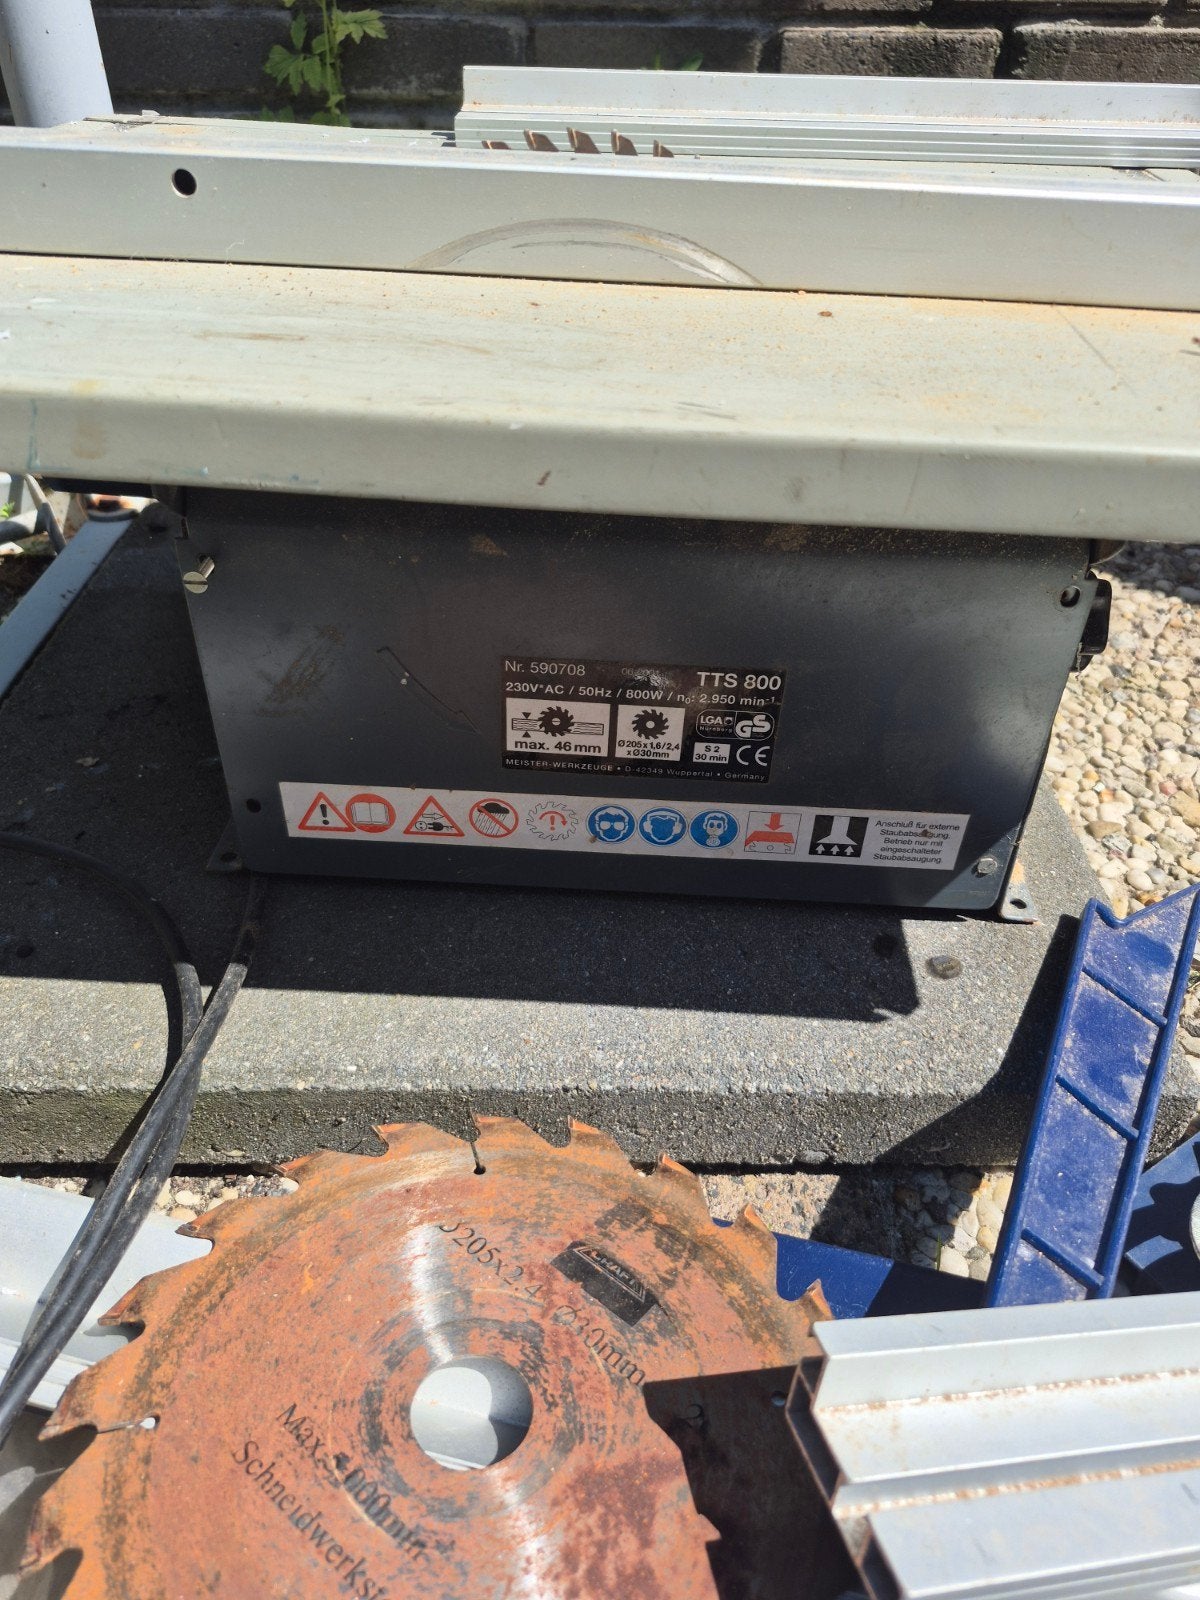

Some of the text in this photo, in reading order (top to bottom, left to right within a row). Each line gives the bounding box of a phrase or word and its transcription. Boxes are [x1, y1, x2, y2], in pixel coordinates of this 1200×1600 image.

[505, 660, 586, 677] Nr. 590708
[697, 671, 781, 690] TTS 800
[578, 686, 612, 698] 50Hz
[626, 689, 663, 700] 800W
[700, 693, 736, 705] 2.950
[700, 715, 723, 725] LGA
[735, 714, 771, 738] GS
[514, 740, 550, 751] max.
[695, 753, 727, 762] 30 min
[736, 744, 771, 767] CE
[505, 758, 613, 772] MEISTER-WERKZEUGE
[666, 768, 713, 778] Wuppertal
[724, 772, 765, 781] Germany
[875, 820, 914, 828] Anschluß
[883, 837, 913, 845] Betrieb
[880, 846, 942, 855] eingeschalteter
[231, 1440, 384, 1600] Schneidwerks
